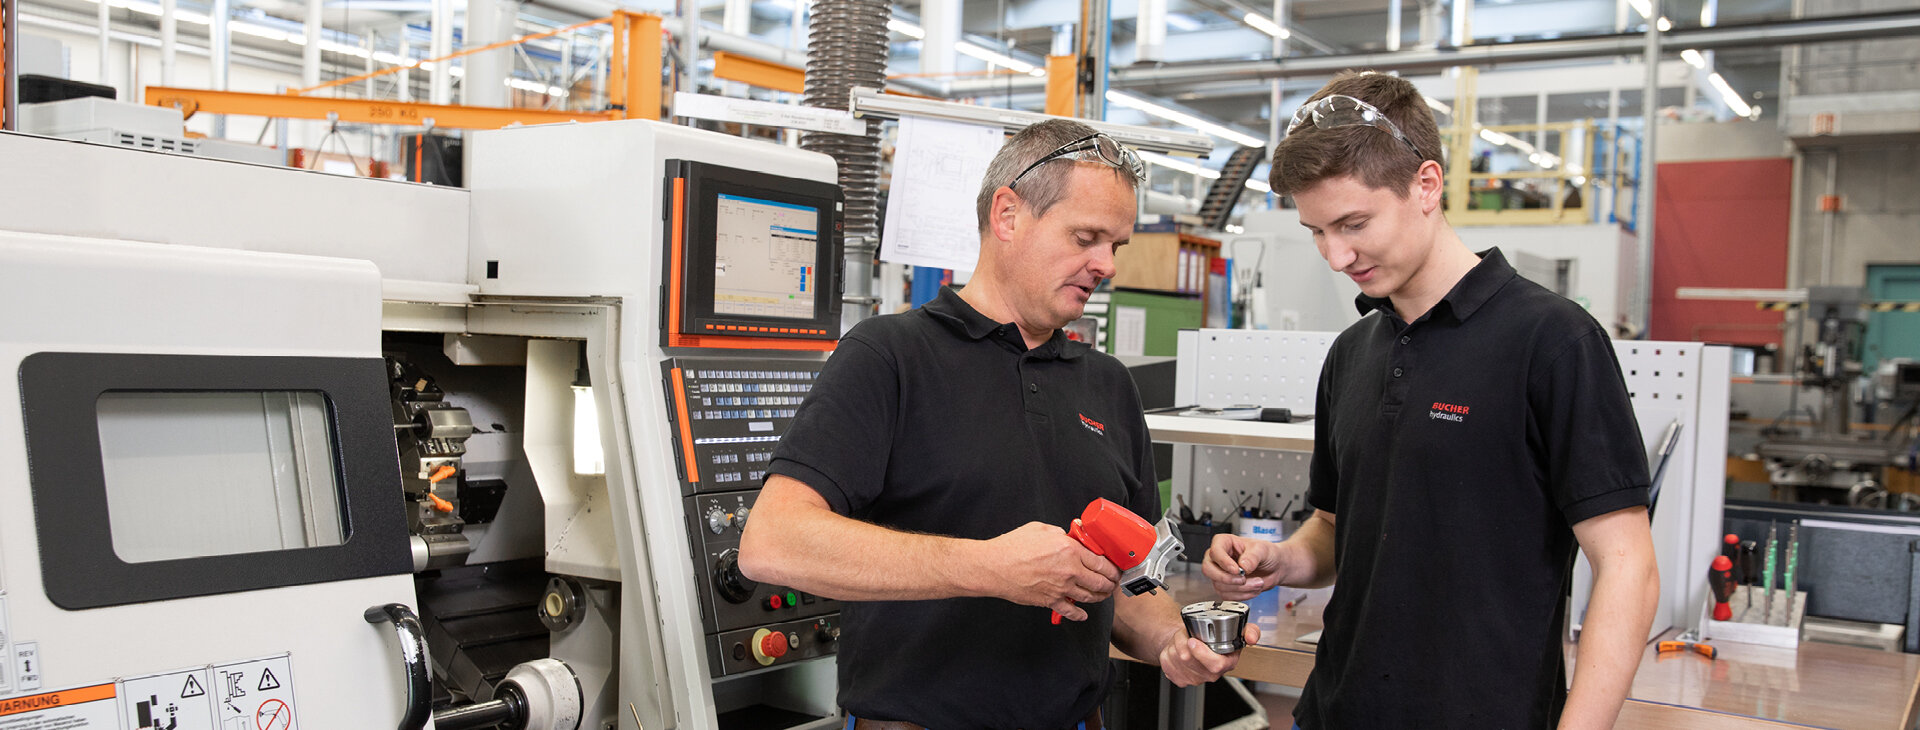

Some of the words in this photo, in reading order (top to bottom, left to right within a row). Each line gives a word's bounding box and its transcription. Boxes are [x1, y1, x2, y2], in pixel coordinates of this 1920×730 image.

[1431, 402, 1470, 415] BUCHER
[1429, 410, 1463, 422] hydraulics
[0, 694, 60, 713] ARNUNG
